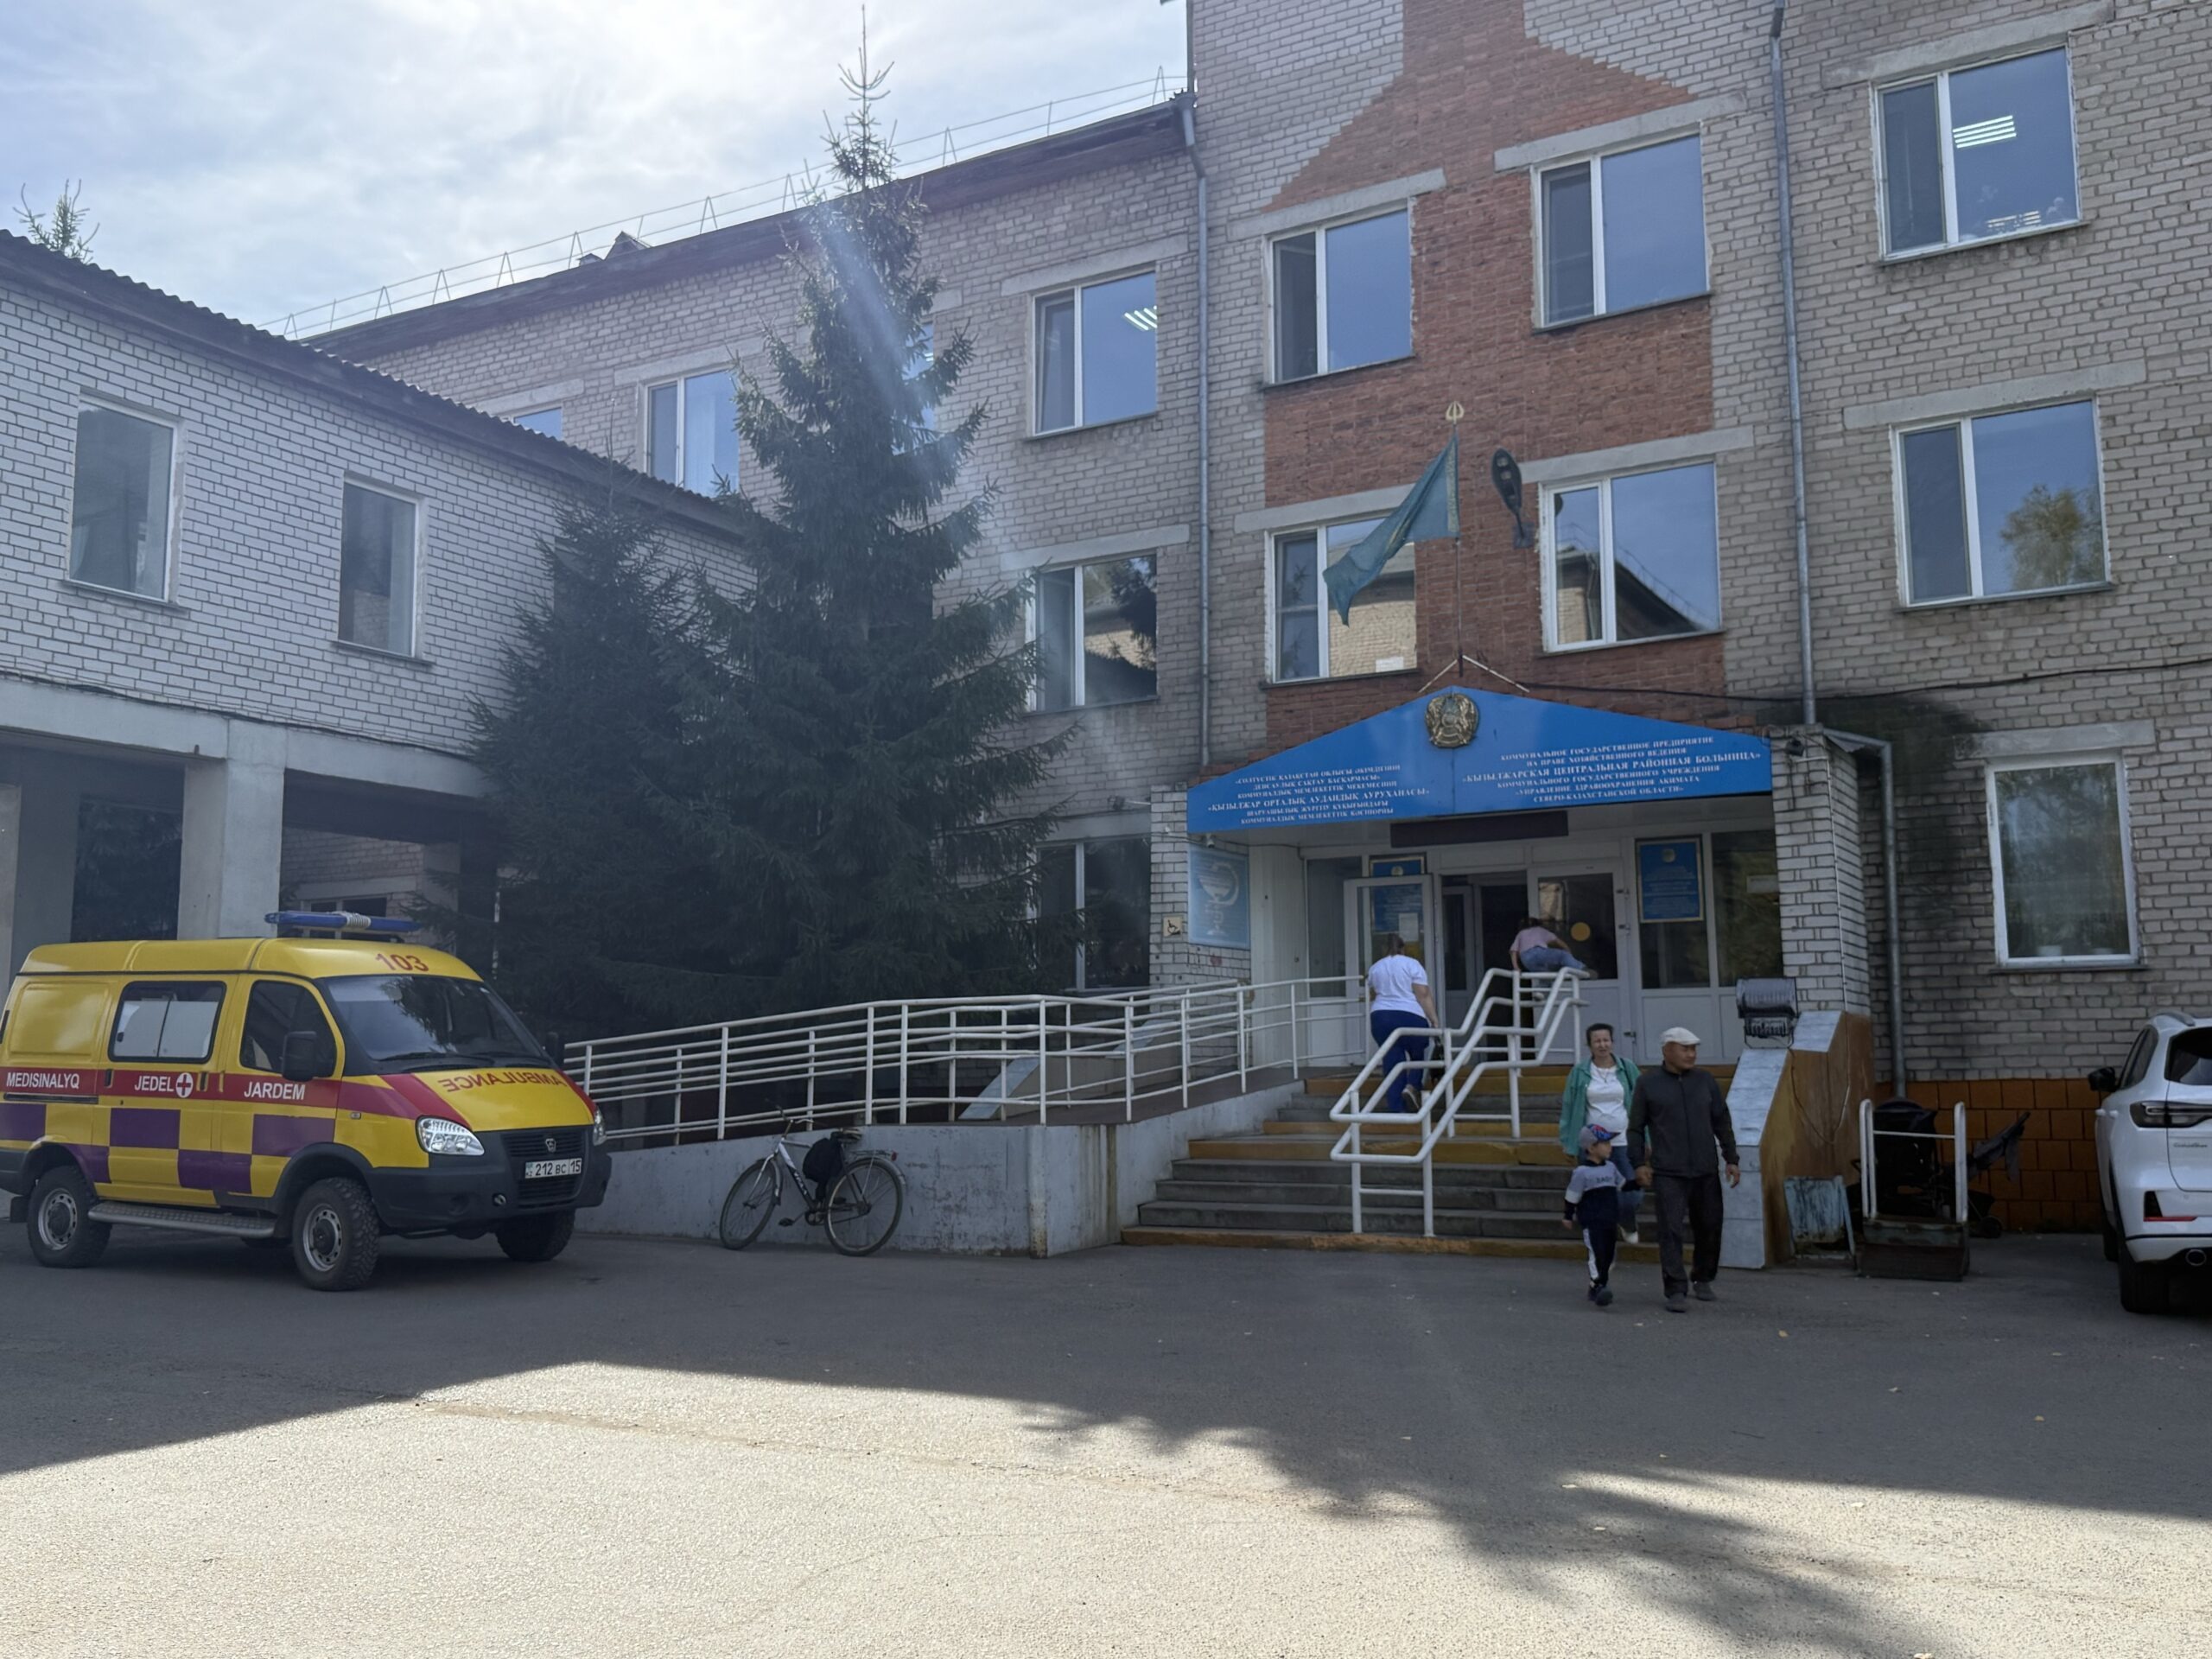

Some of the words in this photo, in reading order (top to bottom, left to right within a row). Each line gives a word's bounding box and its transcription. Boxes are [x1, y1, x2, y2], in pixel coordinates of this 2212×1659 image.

[1554, 761, 1629, 776] ЦЕНТРАЛЬНАЯ
[1633, 756, 1692, 769] РАЙОННАЯ
[1695, 752, 1761, 766] БОЛЬНИЦА»
[1263, 797, 1306, 807] ОРТАЛЫҚ
[1309, 792, 1358, 804] АУДАНДЫҚ
[375, 953, 429, 971] 103
[6, 1072, 79, 1090] MEDISINALYQ
[135, 1076, 175, 1092] JEDEL
[244, 1082, 306, 1101] JARDEM
[536, 1162, 553, 1176] 212
[556, 1164, 567, 1174] BC
[570, 1160, 582, 1173] 15
